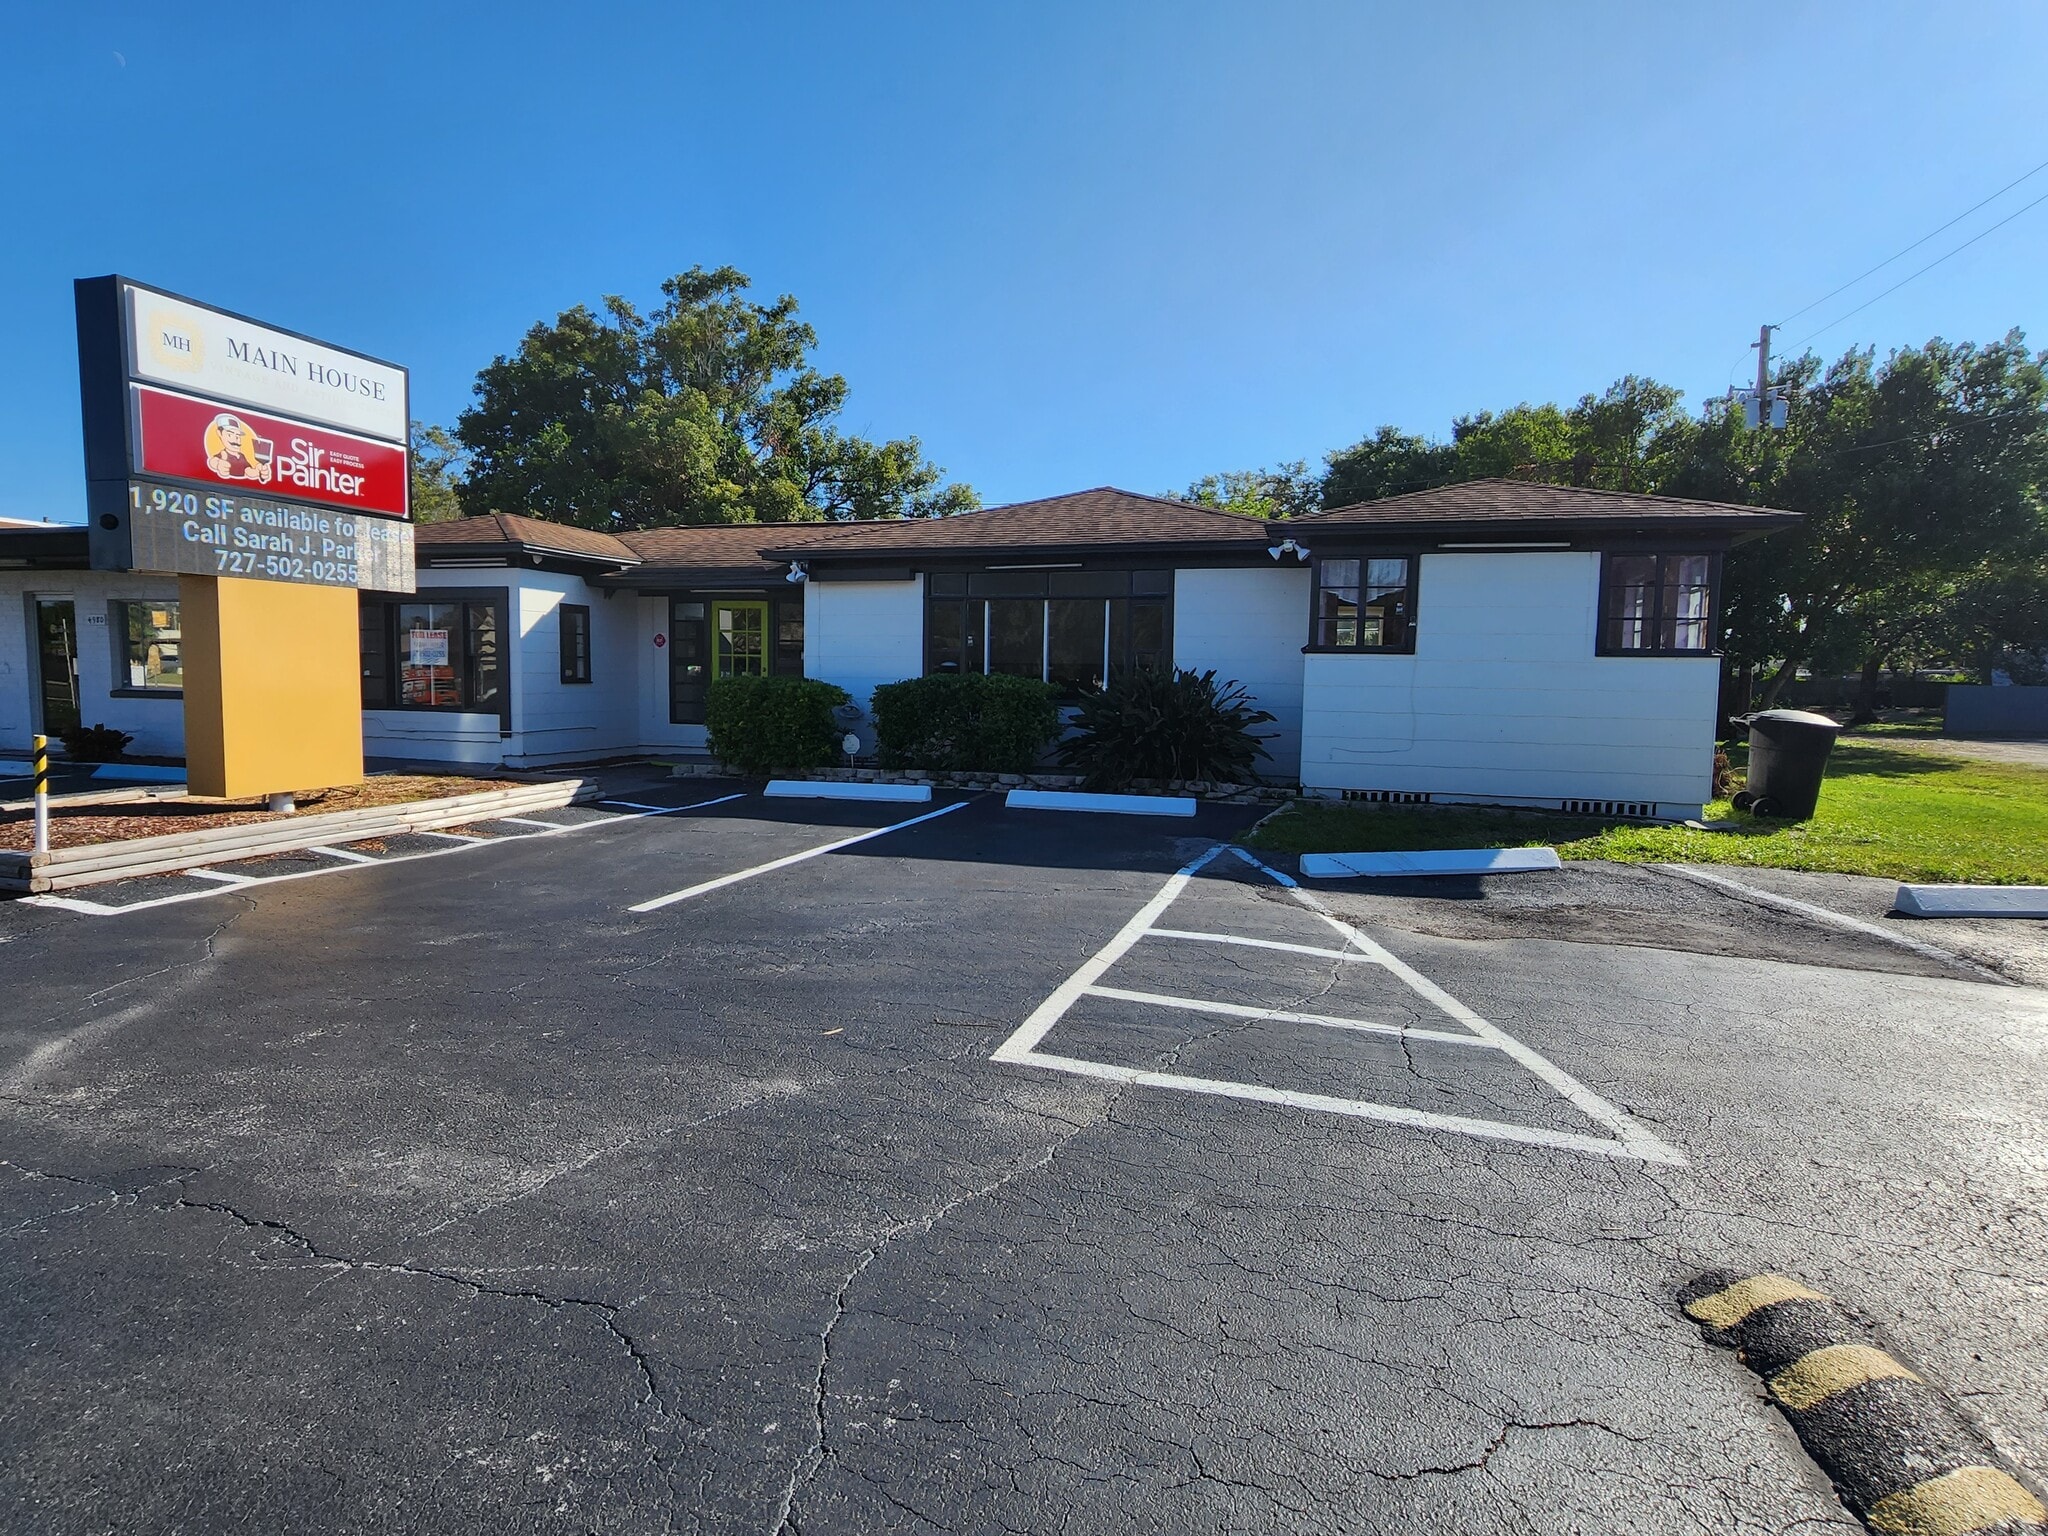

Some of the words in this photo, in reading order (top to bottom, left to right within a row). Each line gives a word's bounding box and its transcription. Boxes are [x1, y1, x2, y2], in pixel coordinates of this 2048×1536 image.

[162, 332, 191, 352] MH
[226, 337, 297, 376] MAIN
[308, 361, 386, 401] HOUSE
[291, 438, 325, 468] Sir
[277, 456, 364, 496] Painter
[128, 485, 198, 516] 1,920
[205, 497, 234, 520] SF
[240, 506, 329, 533] available
[183, 520, 227, 546] Call
[234, 530, 293, 553] Sarah
[299, 540, 317, 556] J.
[214, 550, 358, 583] 727-502-0255
